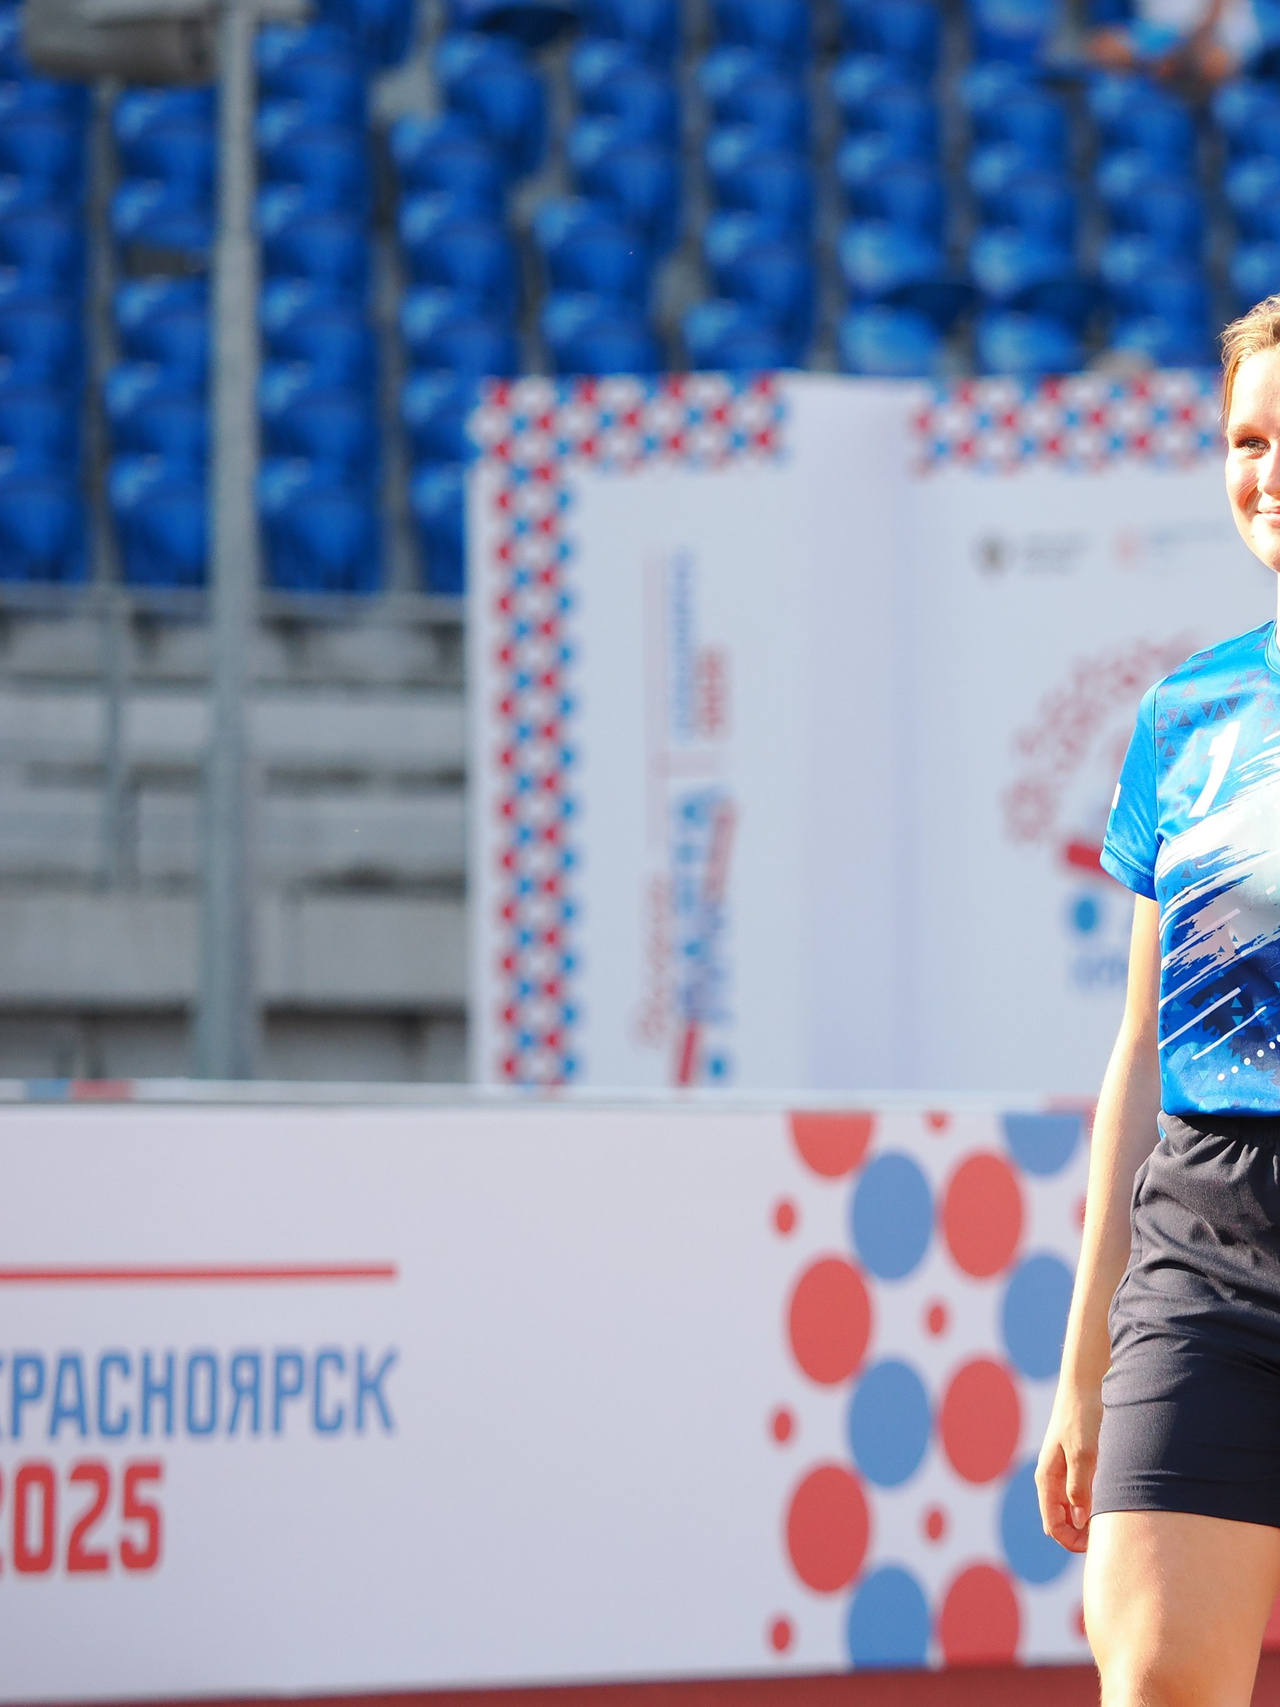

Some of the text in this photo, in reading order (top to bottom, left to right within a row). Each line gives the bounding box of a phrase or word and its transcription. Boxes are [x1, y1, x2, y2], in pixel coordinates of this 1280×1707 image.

[1187, 720, 1241, 819] 1
[0, 1344, 399, 1442] РАСНОЯРСК
[0, 1457, 166, 1577] 025
